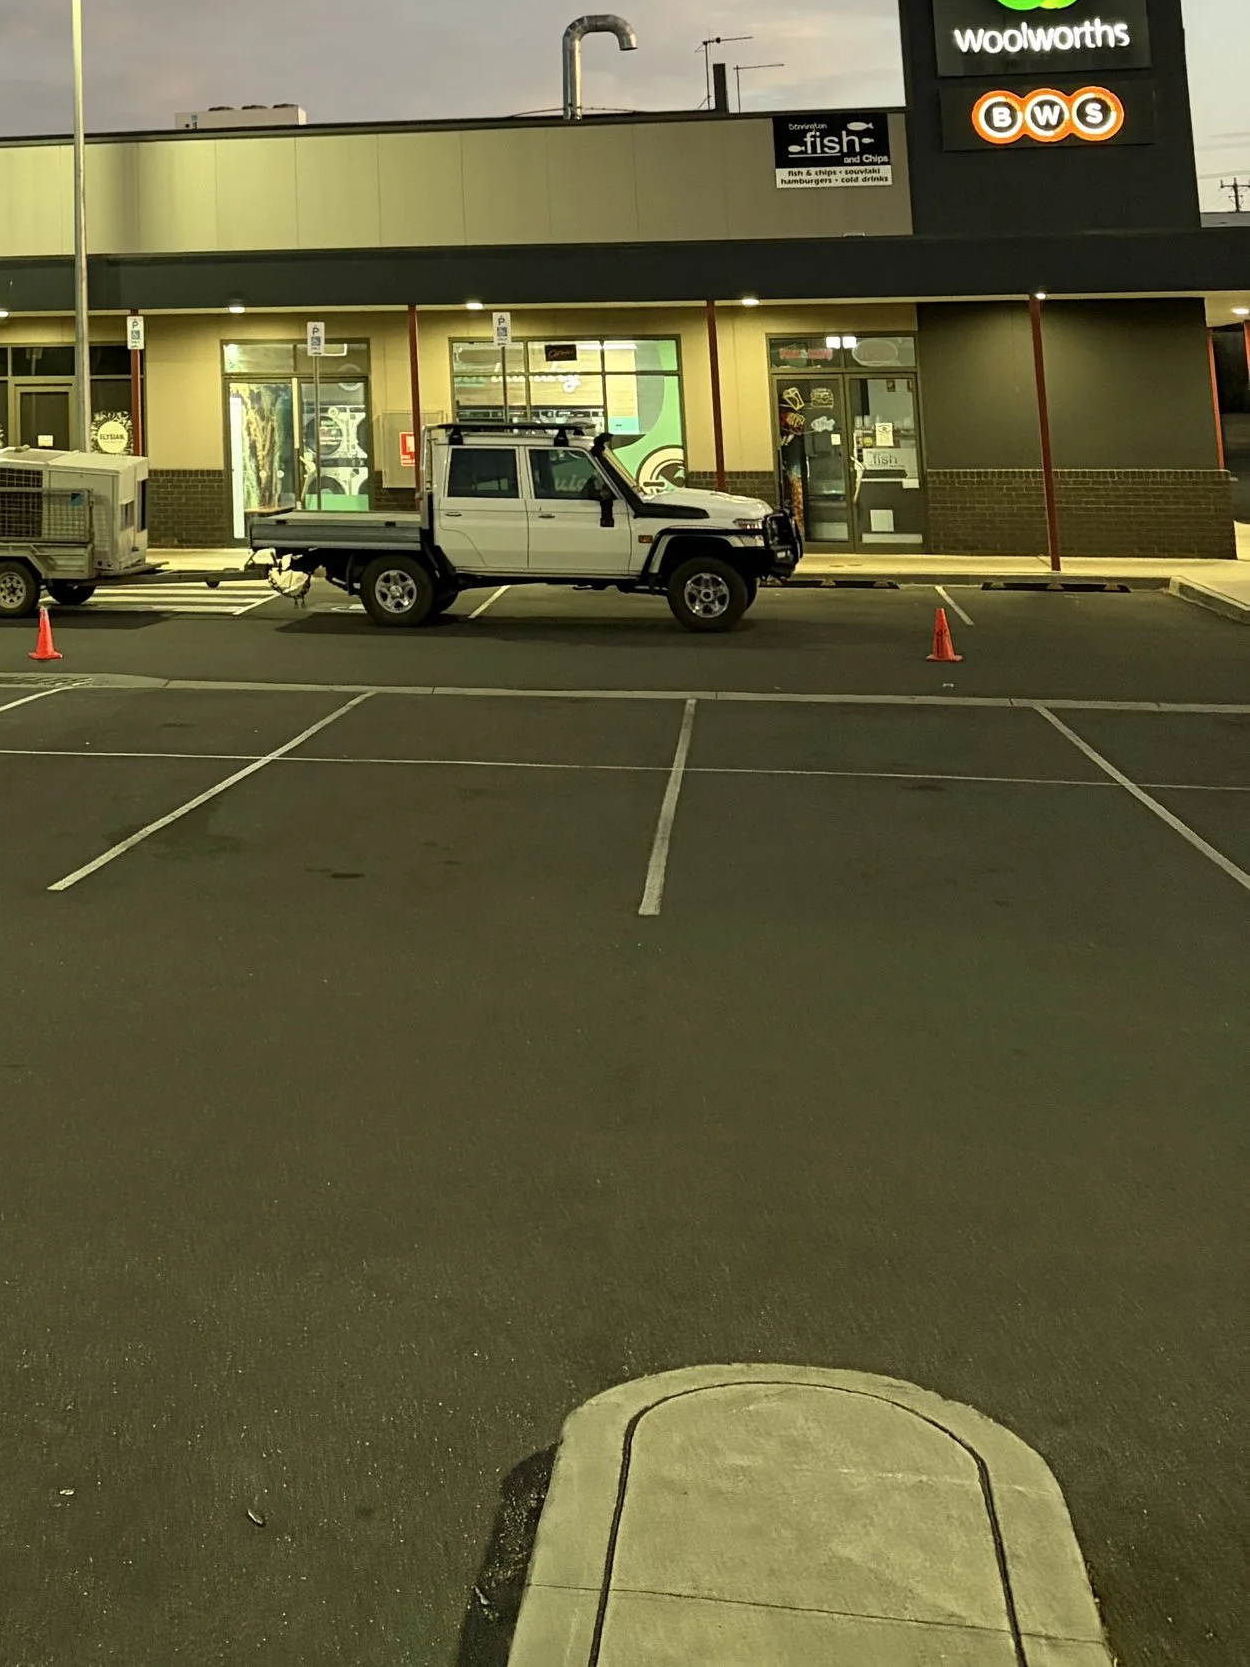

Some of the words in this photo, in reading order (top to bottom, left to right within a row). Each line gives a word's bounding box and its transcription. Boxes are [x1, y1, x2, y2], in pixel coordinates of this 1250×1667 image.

[954, 18, 1130, 53] woolworths
[803, 130, 860, 154] fish
[843, 155, 860, 164] and
[862, 154, 889, 164] Chips
[815, 169, 837, 177] chips
[861, 175, 889, 183] drinks
[871, 452, 898, 465] fish
